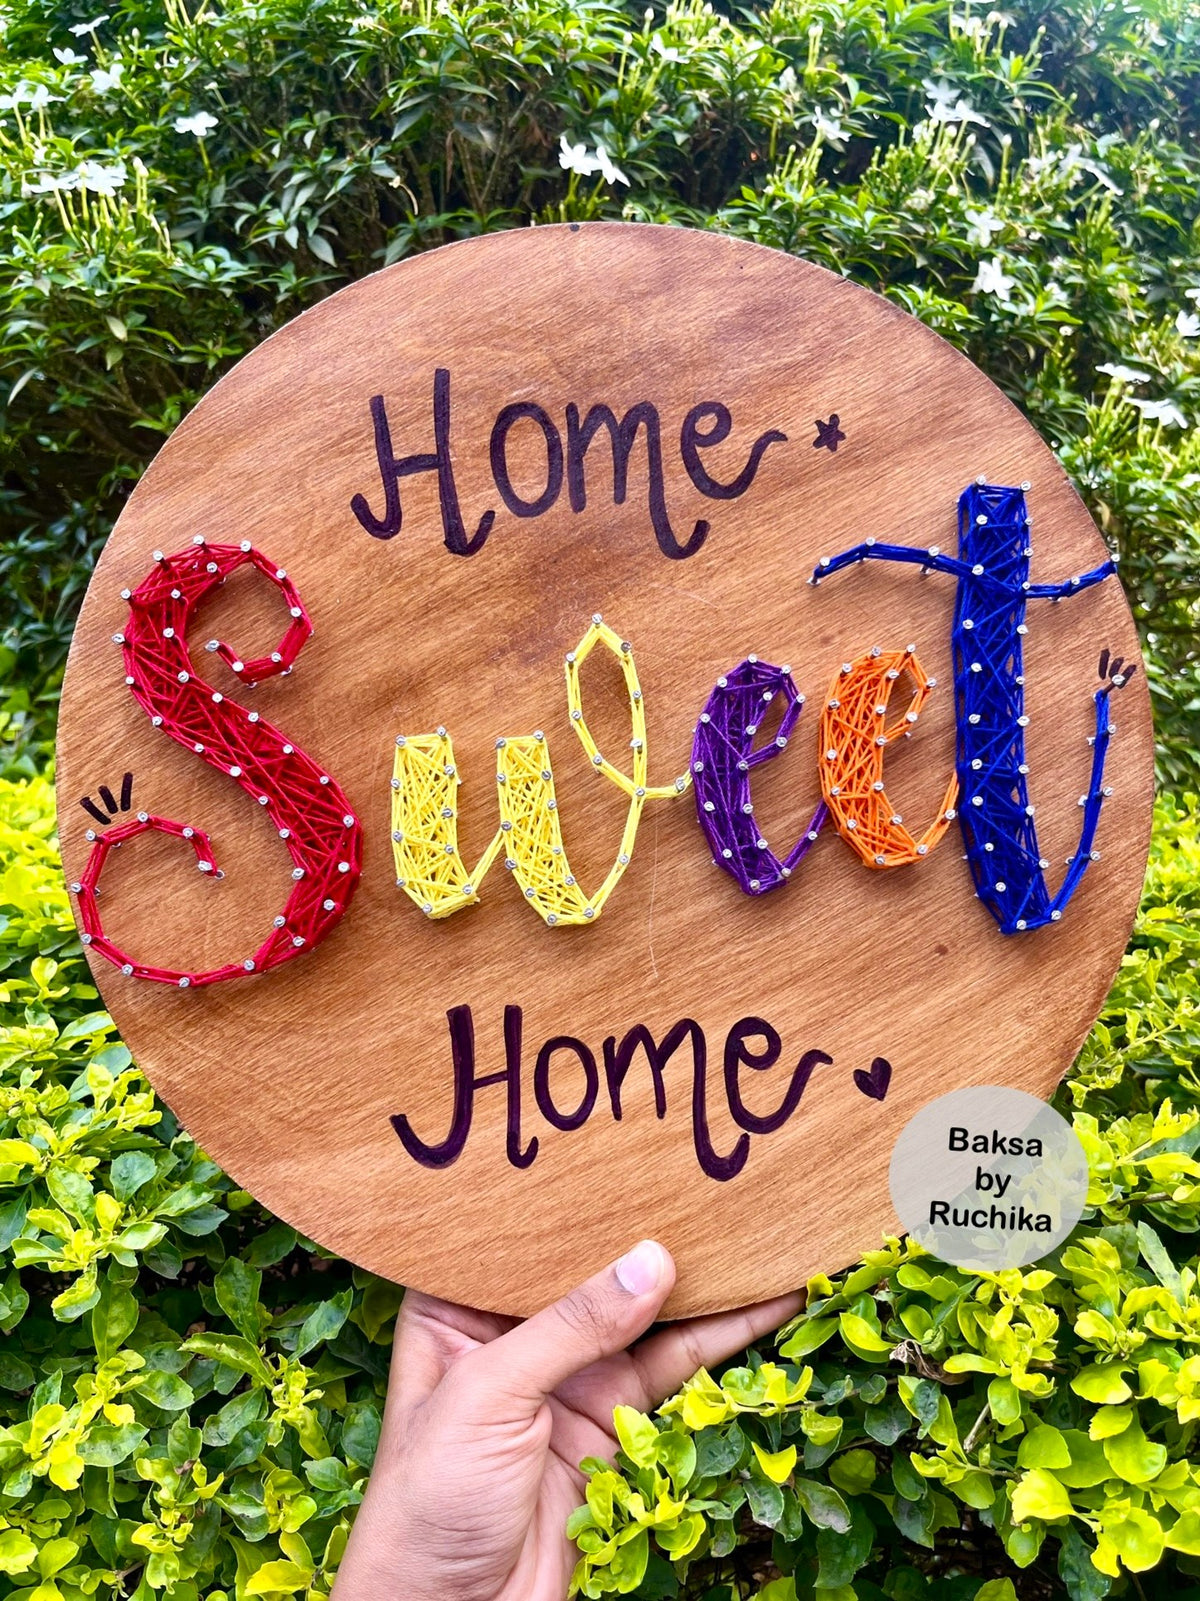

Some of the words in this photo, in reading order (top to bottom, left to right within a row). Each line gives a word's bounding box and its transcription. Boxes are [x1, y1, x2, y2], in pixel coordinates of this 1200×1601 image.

[351, 368, 788, 560] Home
[73, 477, 1122, 988] Sweet
[390, 1003, 833, 1180] Home
